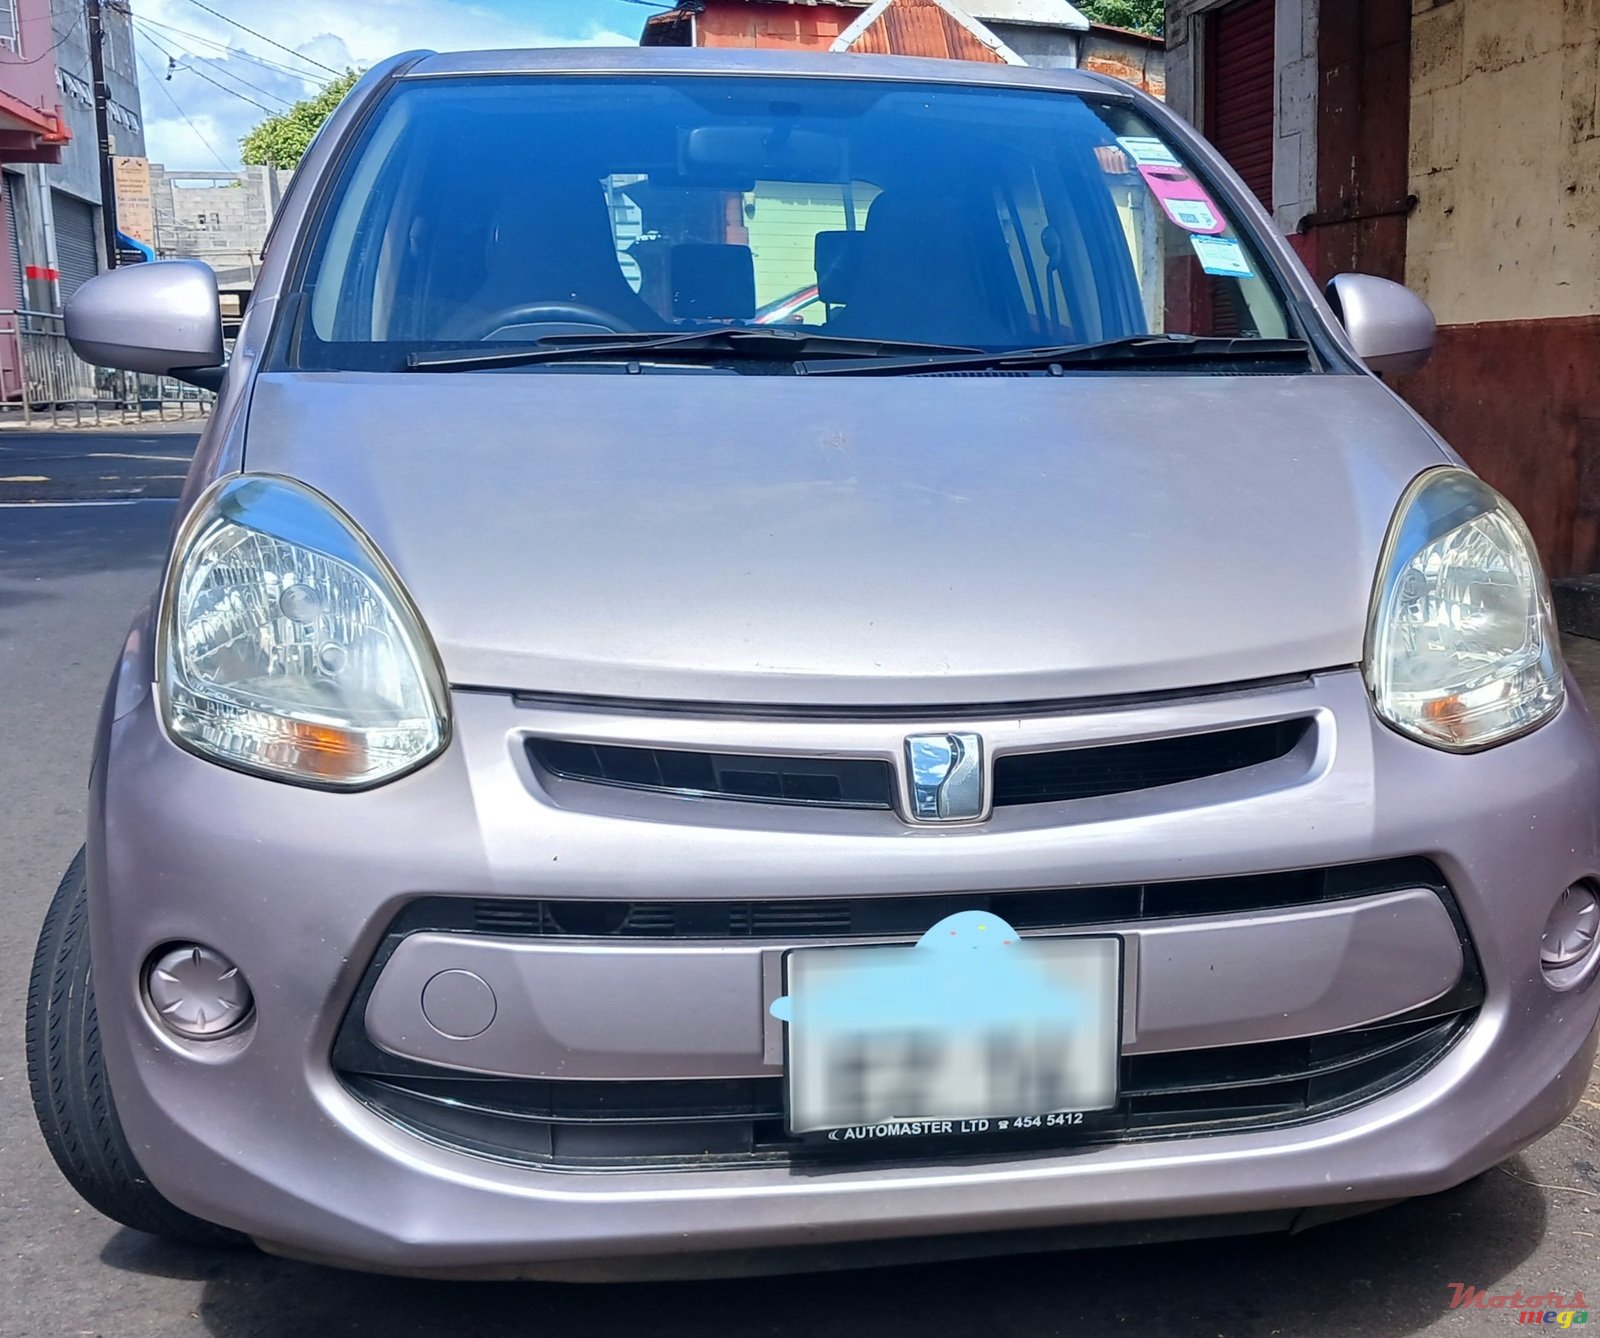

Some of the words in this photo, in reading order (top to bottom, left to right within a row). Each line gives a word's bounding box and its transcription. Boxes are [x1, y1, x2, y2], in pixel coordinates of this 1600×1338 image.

[844, 1121, 953, 1140] AUTOMASTER
[961, 1119, 989, 1133] LTD
[1013, 1115, 1042, 1128] 454
[1046, 1112, 1083, 1126] 5412
